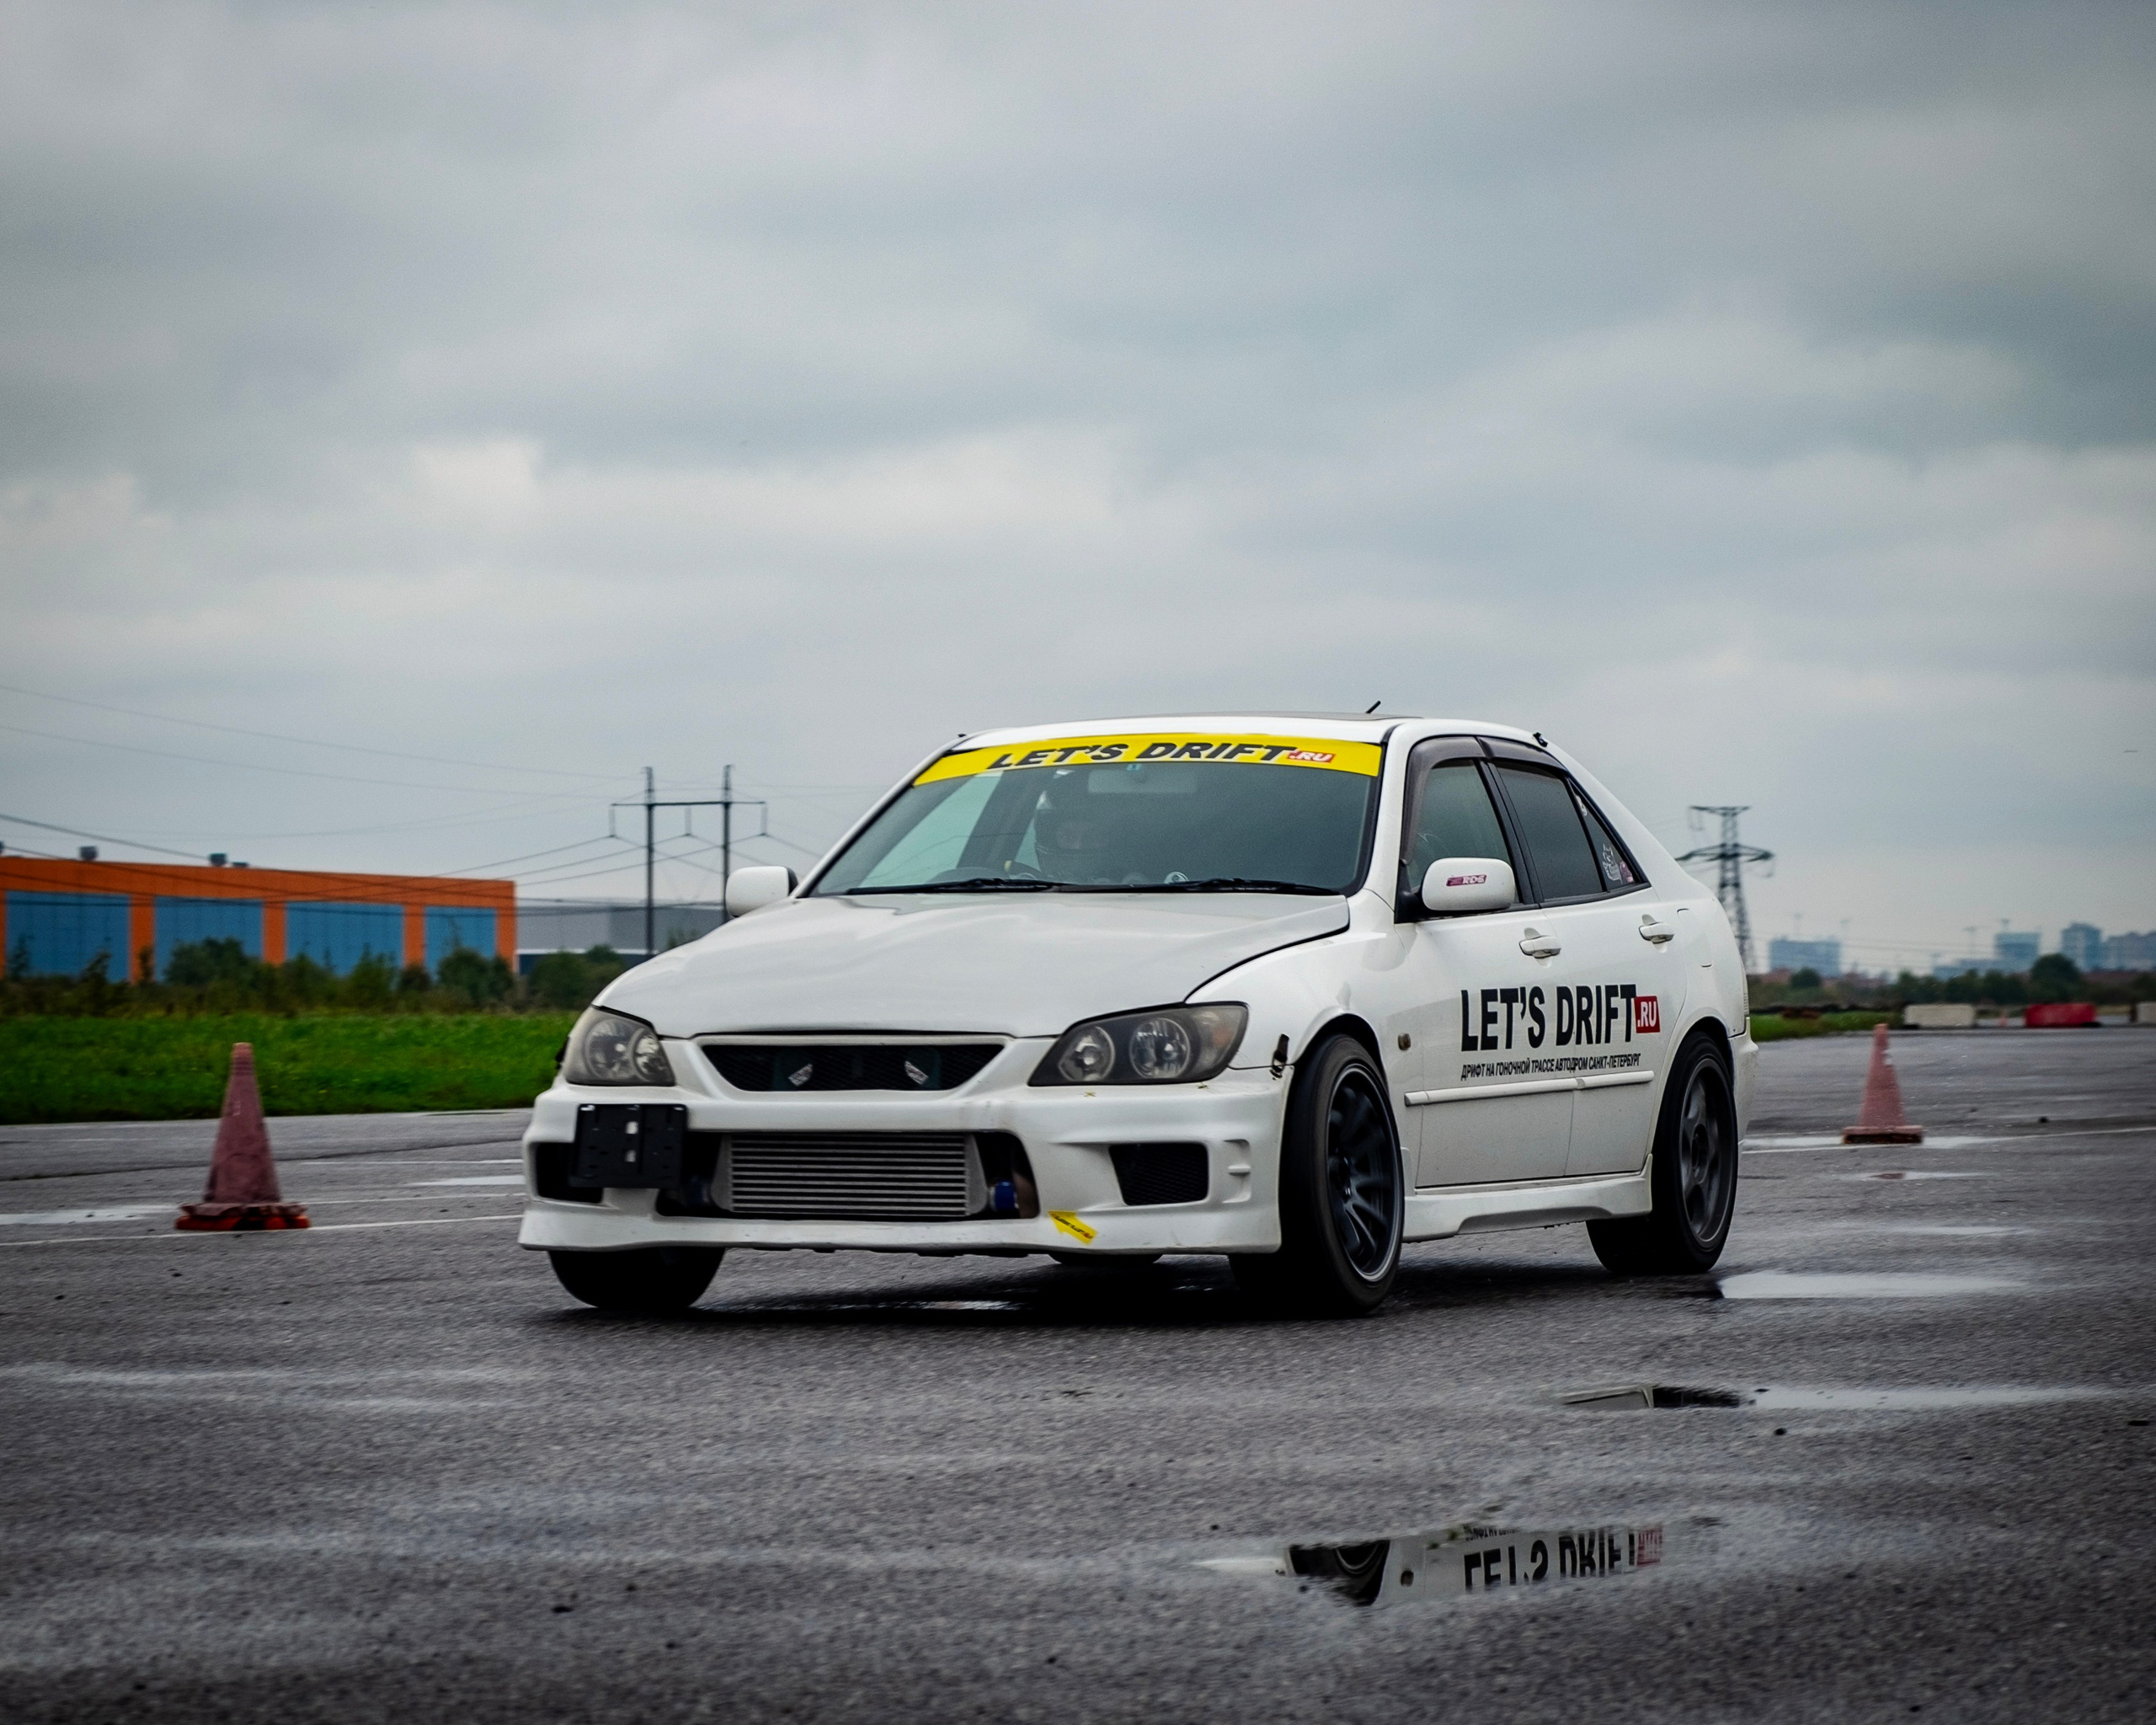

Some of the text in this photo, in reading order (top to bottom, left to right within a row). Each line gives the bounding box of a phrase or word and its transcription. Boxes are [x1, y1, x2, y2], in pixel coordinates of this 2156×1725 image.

[986, 743, 1129, 770] LET'S
[1460, 985, 1546, 1052] LET'S
[1460, 1053, 1641, 1081] ДРИФТ НА ГОНОЧНОЙ ТРАССЕ АВТОДРОМ САНКТ-ПЕТЕРБУРГ
